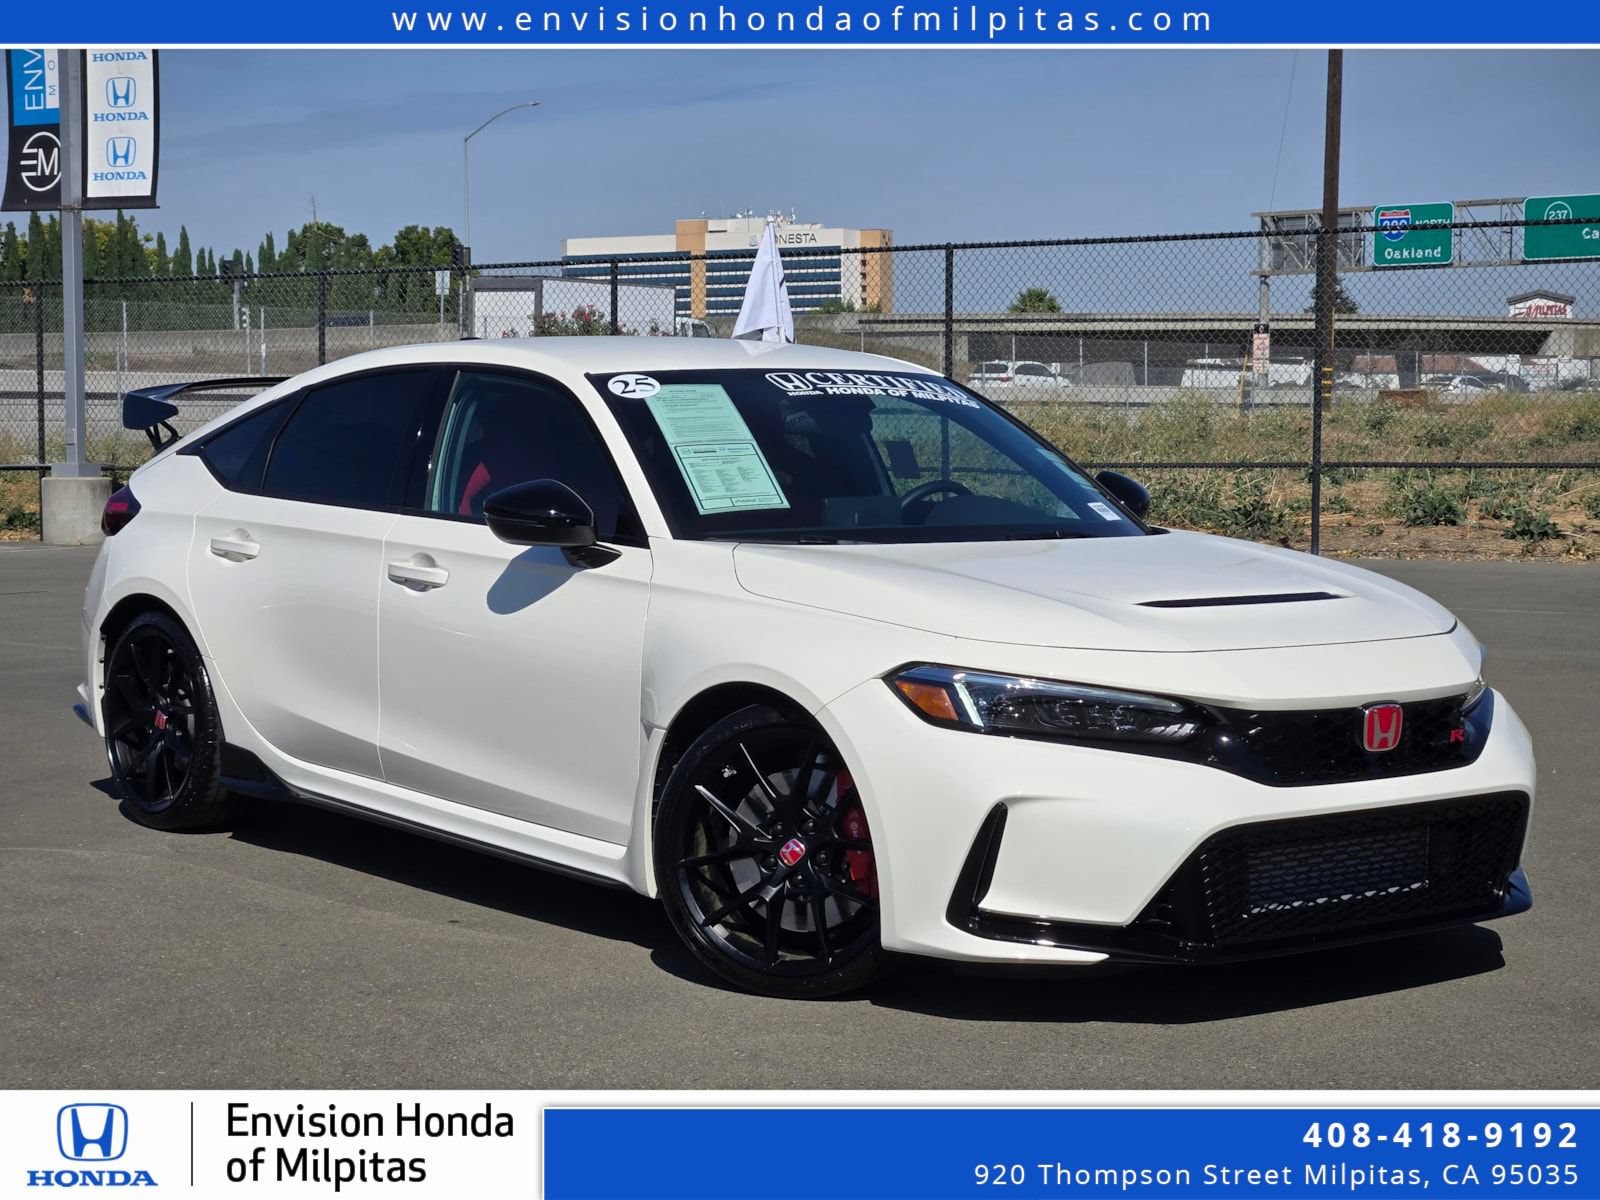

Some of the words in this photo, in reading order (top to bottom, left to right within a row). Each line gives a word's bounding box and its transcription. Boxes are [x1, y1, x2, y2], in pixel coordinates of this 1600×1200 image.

[92, 52, 148, 62] HONDA
[93, 112, 149, 122] HONDA
[93, 171, 148, 181] HONDA
[1548, 210, 1568, 220] 237
[1384, 246, 1442, 259] Oakland
[612, 377, 656, 394] 25
[805, 372, 968, 399] CERTIFIED
[825, 387, 887, 395] HONDA
[887, 389, 909, 397] OF
[911, 391, 981, 409] MILPITAS
